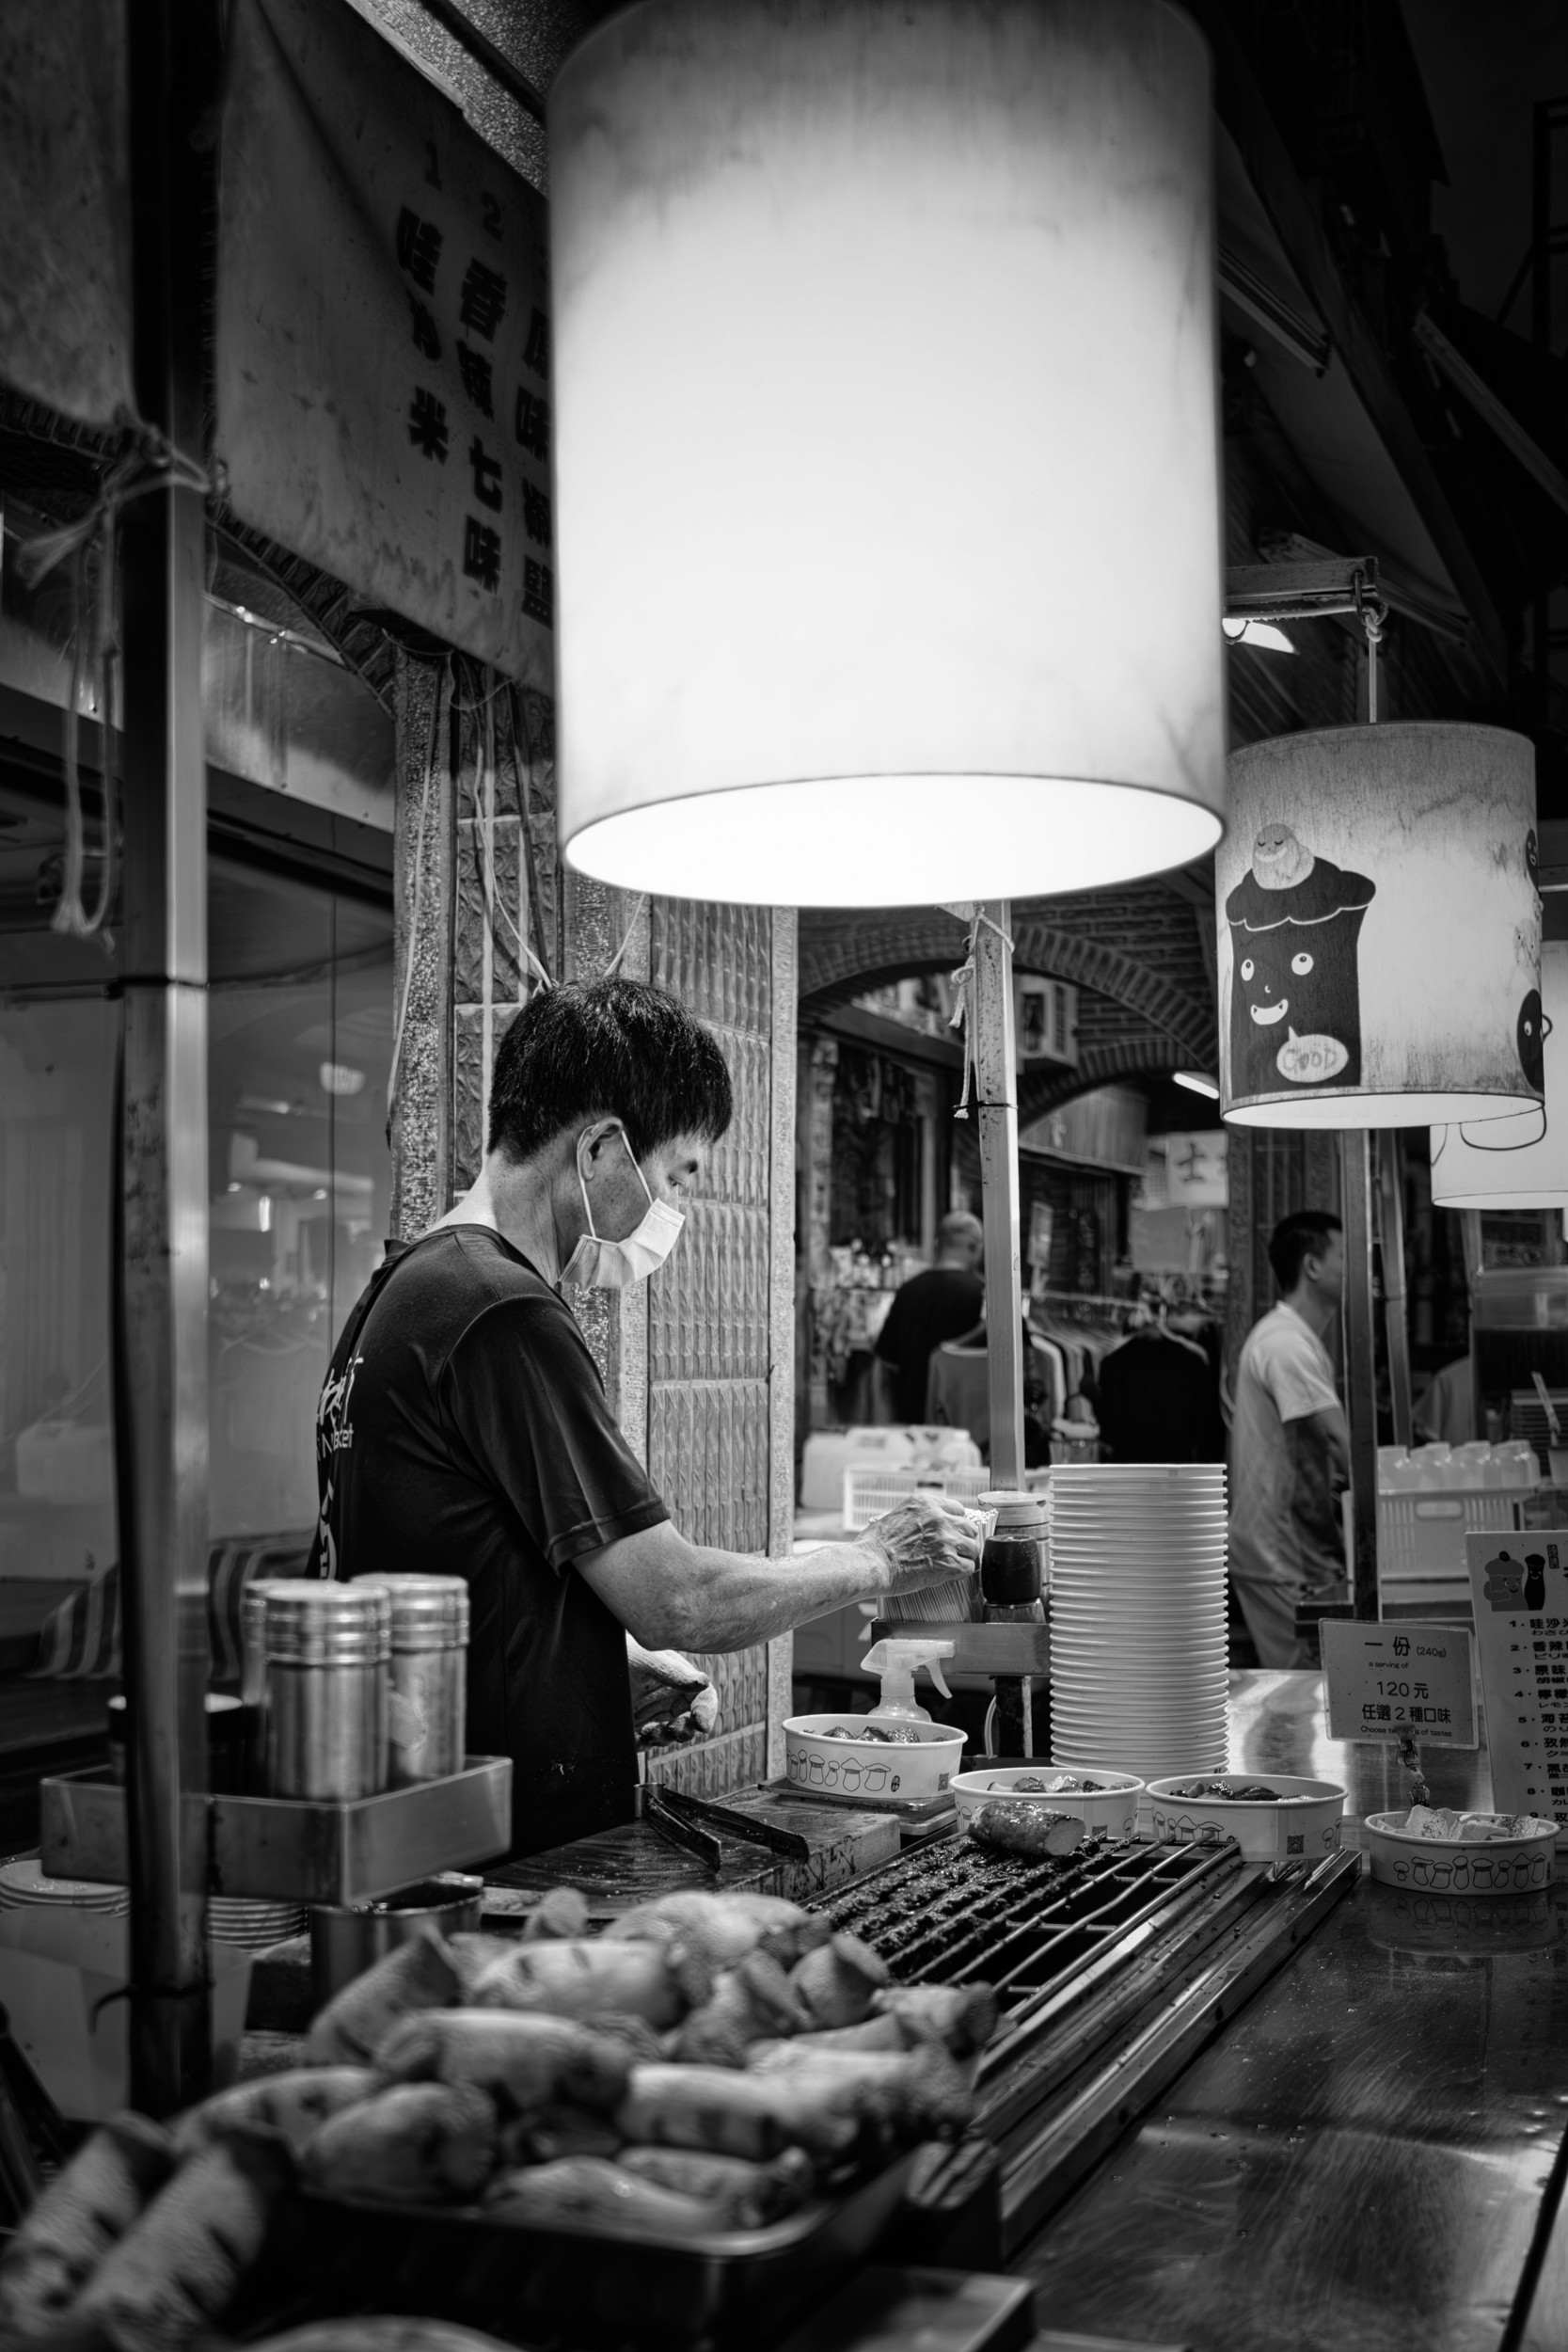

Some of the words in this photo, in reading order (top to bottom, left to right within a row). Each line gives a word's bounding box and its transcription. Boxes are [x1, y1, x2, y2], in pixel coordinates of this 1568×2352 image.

[424, 140, 442, 192] 1
[481, 190, 505, 243] 2
[1282, 1046, 1339, 1073] GOOD
[1416, 1645, 1447, 1659] (240g)
[1374, 1661, 1400, 1669] serving
[1535, 1664, 1567, 1676] 原味
[1360, 1724, 1386, 1734] Choose
[1430, 1729, 1452, 1738] tastes
